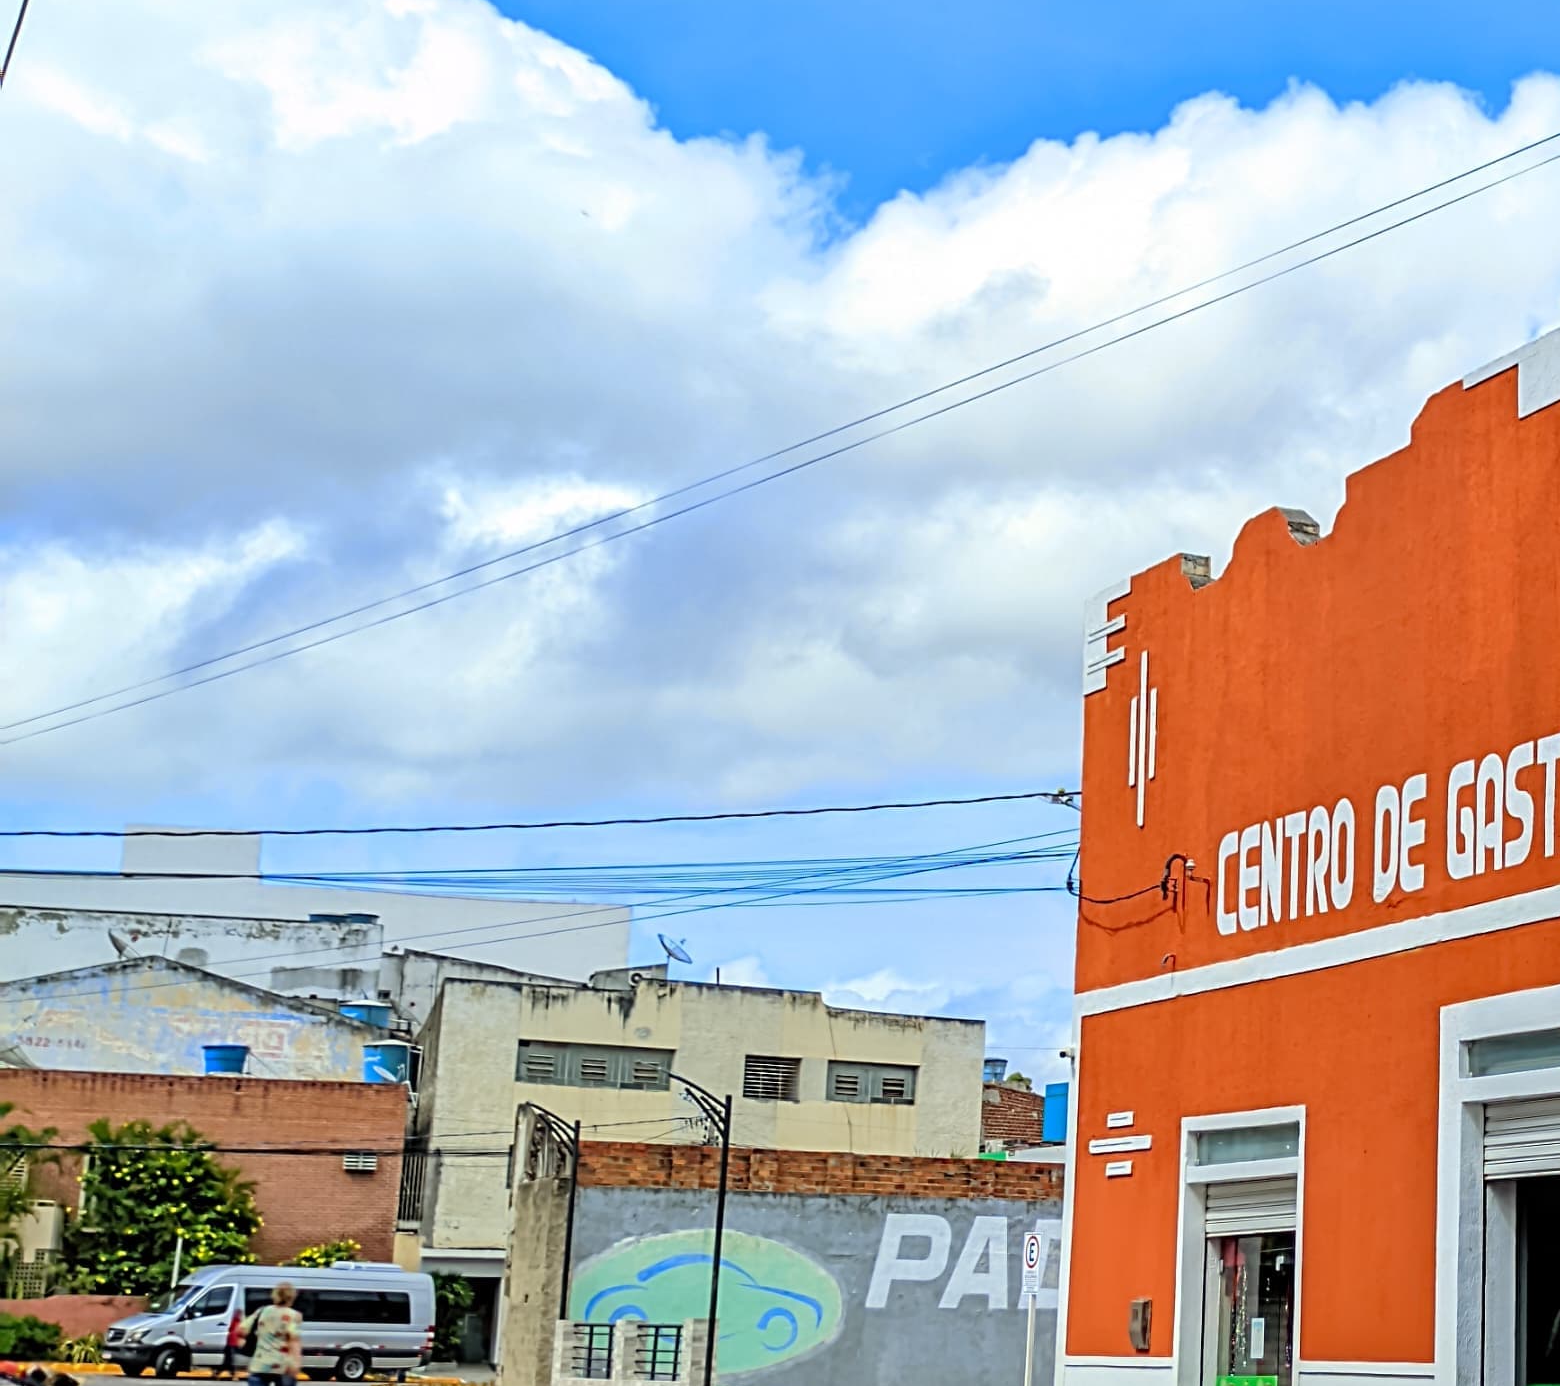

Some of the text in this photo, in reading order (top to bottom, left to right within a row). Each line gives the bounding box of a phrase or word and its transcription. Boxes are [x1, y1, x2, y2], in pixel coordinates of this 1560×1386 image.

[1216, 797, 1355, 936] CENTRO
[1373, 773, 1428, 904] DE
[1029, 1242, 1036, 1262] E
